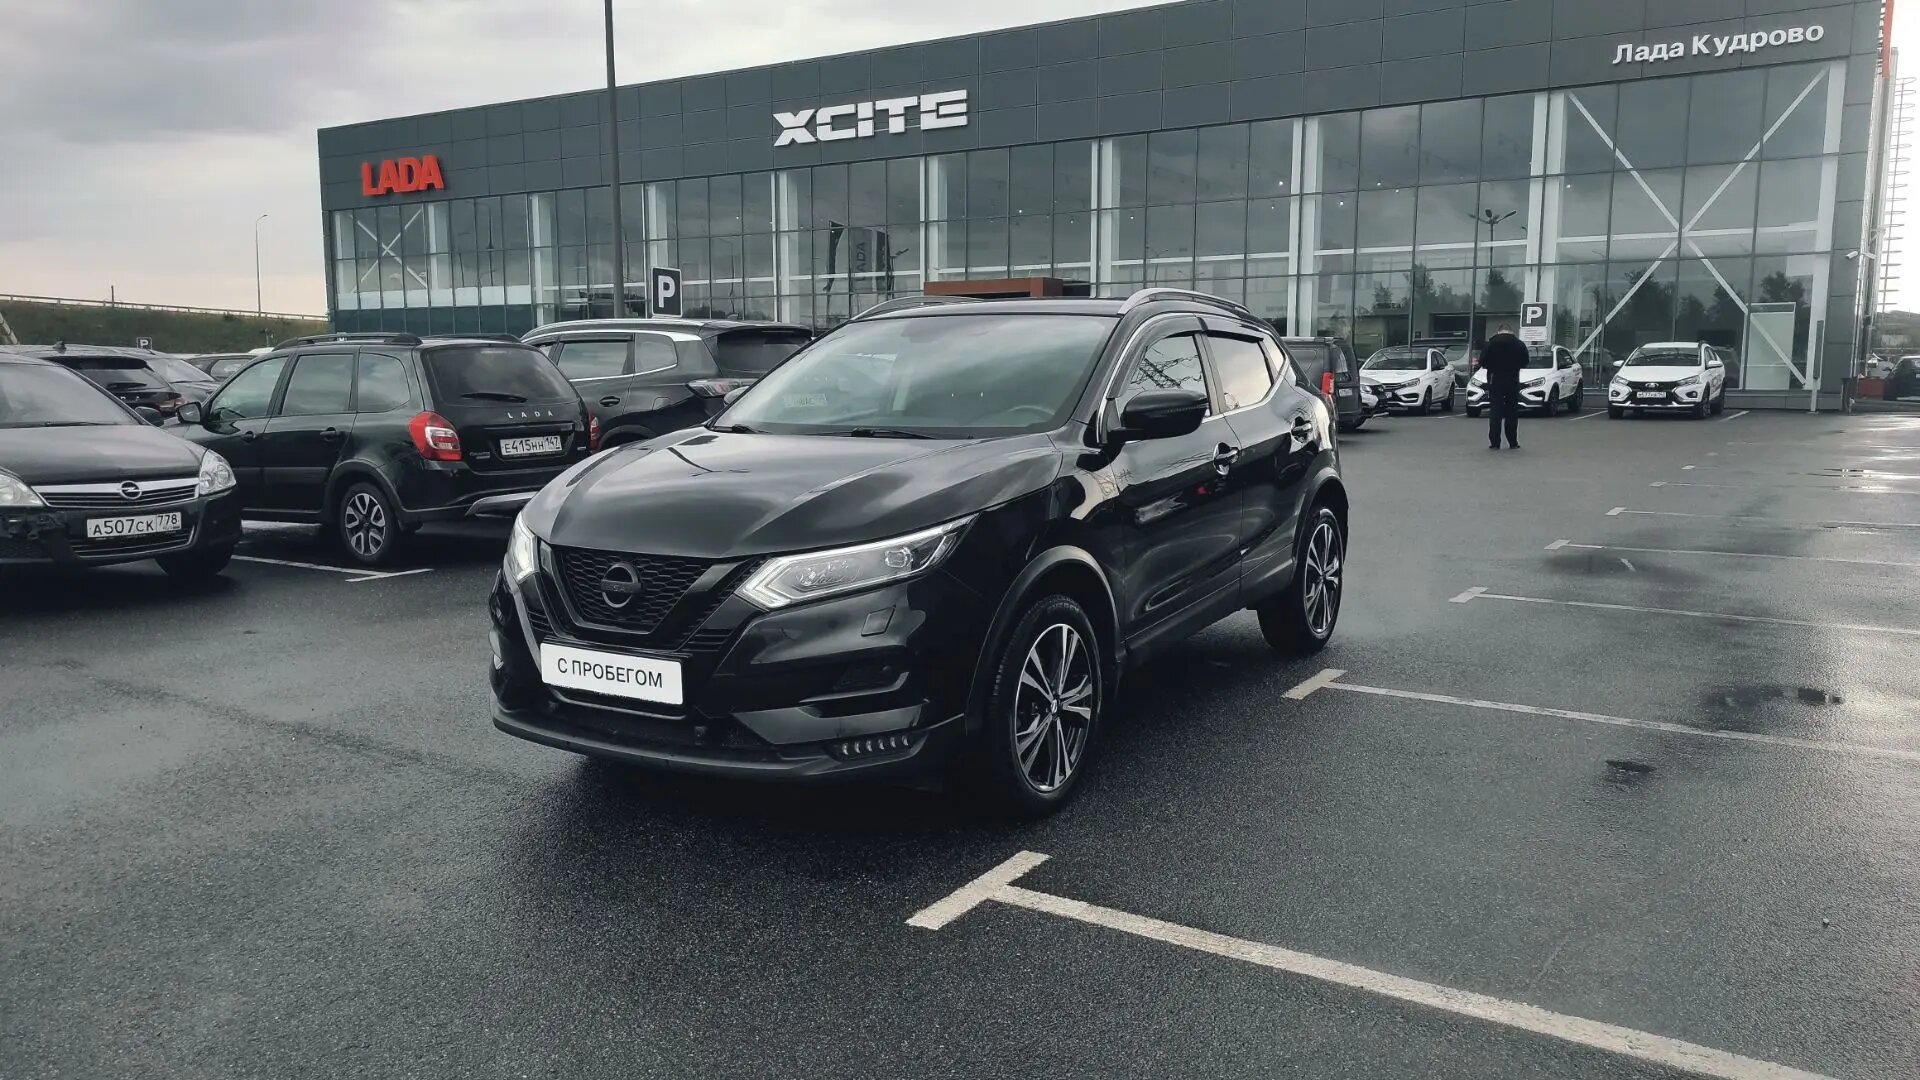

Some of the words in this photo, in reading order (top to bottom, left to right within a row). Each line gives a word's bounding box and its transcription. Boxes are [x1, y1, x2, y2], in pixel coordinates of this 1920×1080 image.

[1612, 42, 1684, 65] Лада
[1692, 25, 1825, 57] Кудрово
[772, 89, 968, 147] XCITE
[361, 154, 445, 196] LADA
[657, 275, 676, 308] P
[1526, 306, 1543, 324] P
[507, 410, 554, 419] LADA
[557, 657, 568, 674] С
[571, 660, 663, 689] ПРОБЕГОМ
